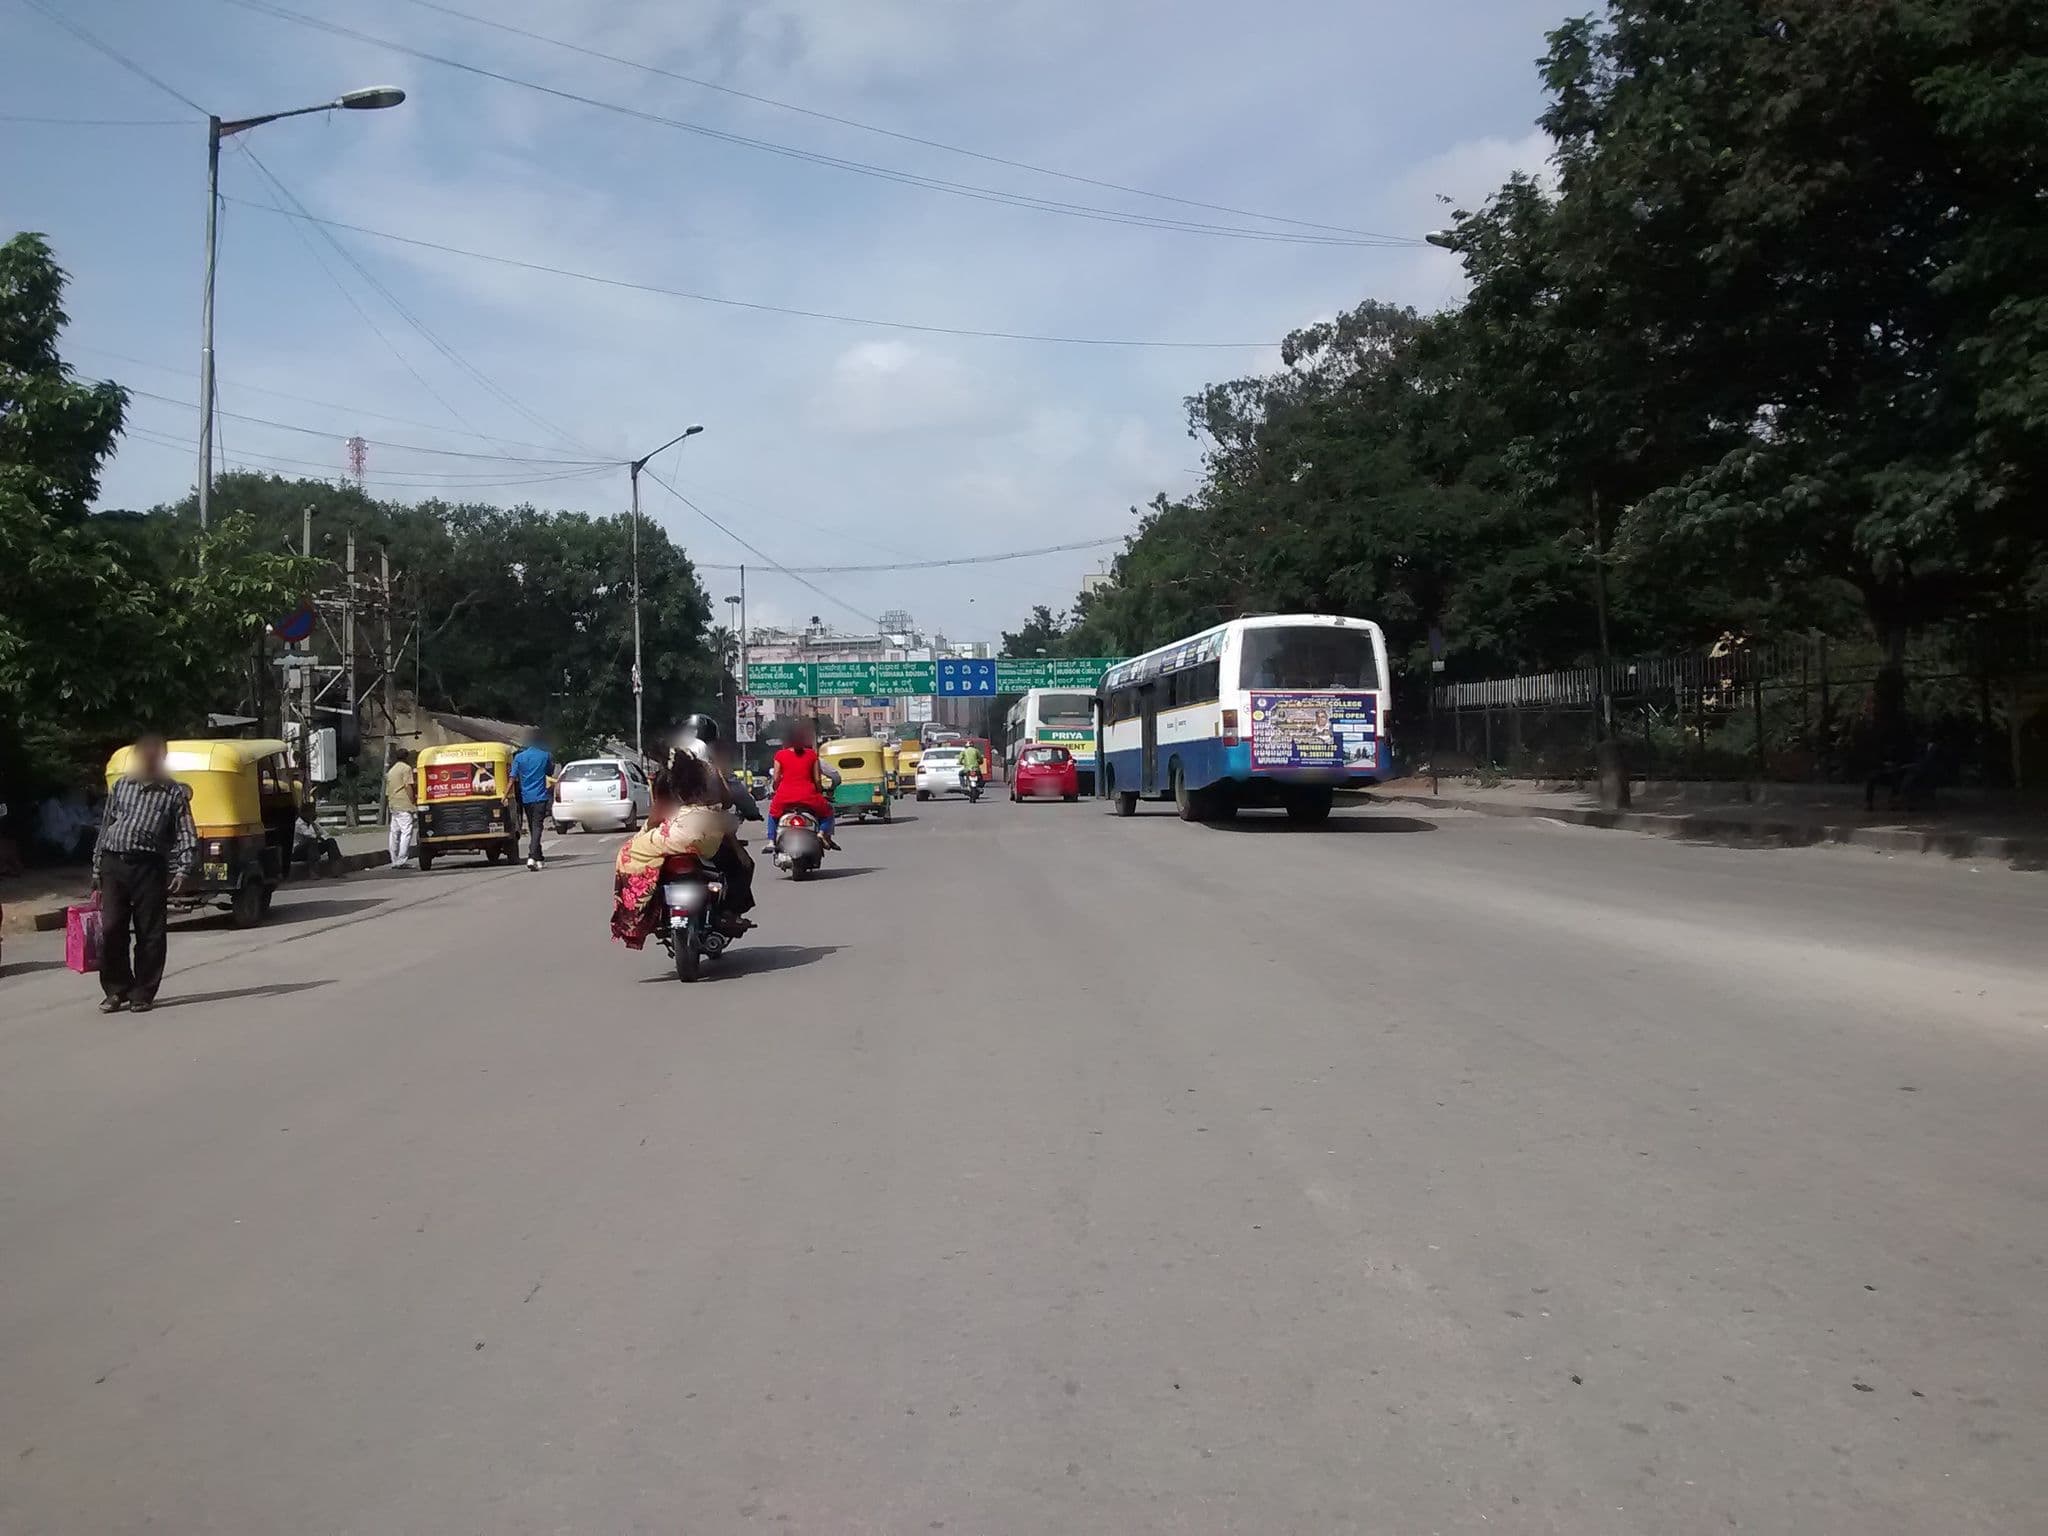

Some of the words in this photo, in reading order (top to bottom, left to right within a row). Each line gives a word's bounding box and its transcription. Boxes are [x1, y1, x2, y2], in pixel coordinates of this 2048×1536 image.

[945, 680, 955, 691] B
[962, 680, 972, 691] D
[979, 680, 989, 691] A
[1052, 732, 1083, 740] PRIYA
